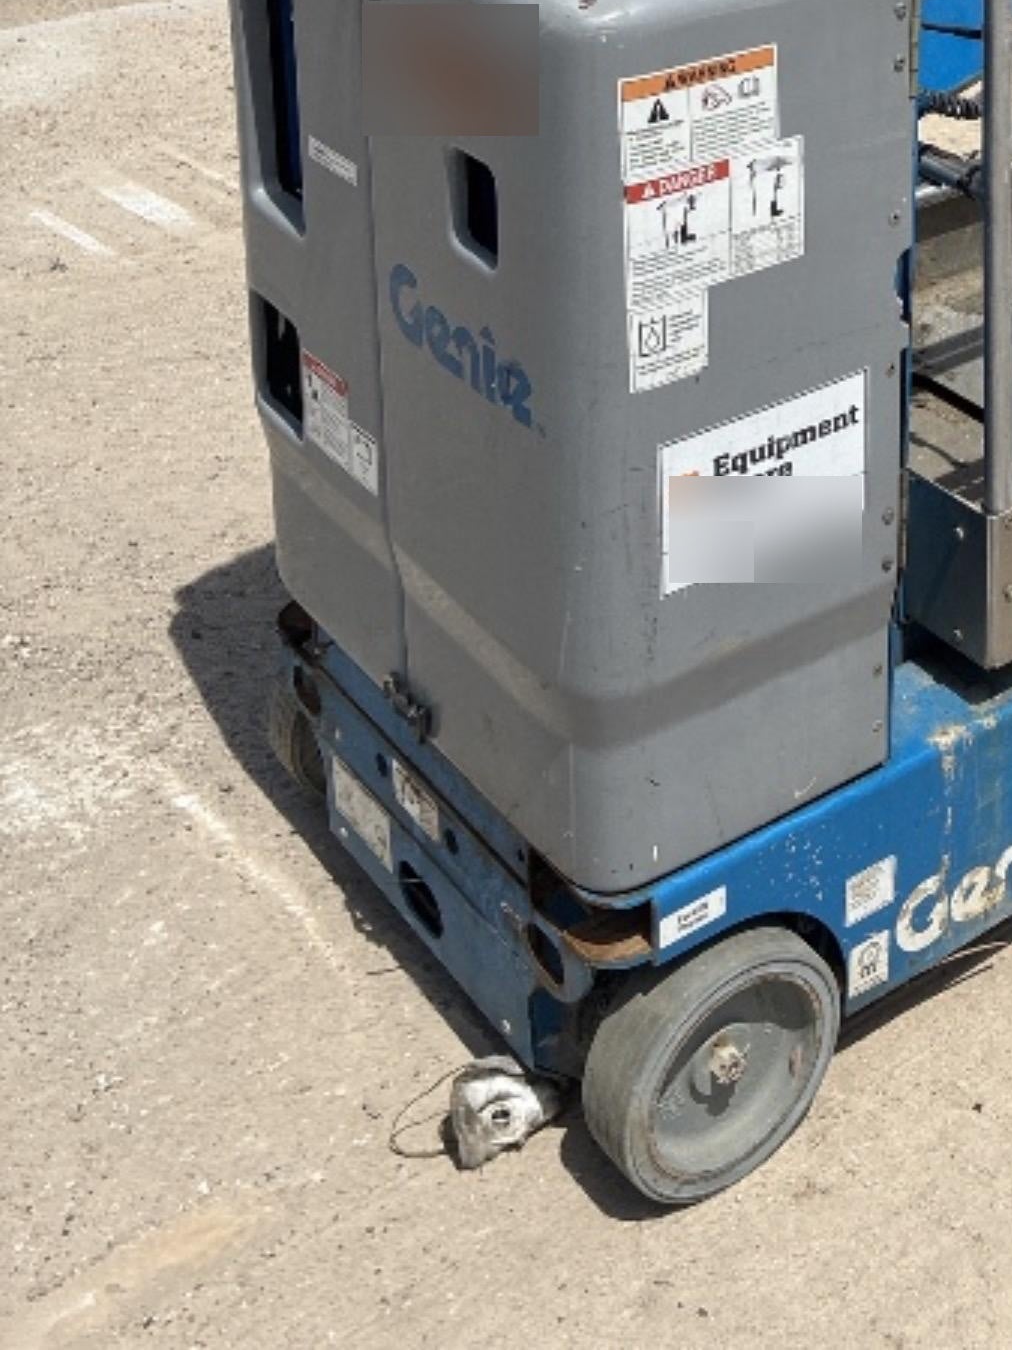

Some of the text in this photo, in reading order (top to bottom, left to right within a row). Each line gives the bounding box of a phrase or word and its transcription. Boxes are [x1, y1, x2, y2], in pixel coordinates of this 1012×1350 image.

[658, 161, 717, 195] DANGER
[389, 263, 534, 429] Genie
[712, 404, 860, 477] Equipment
